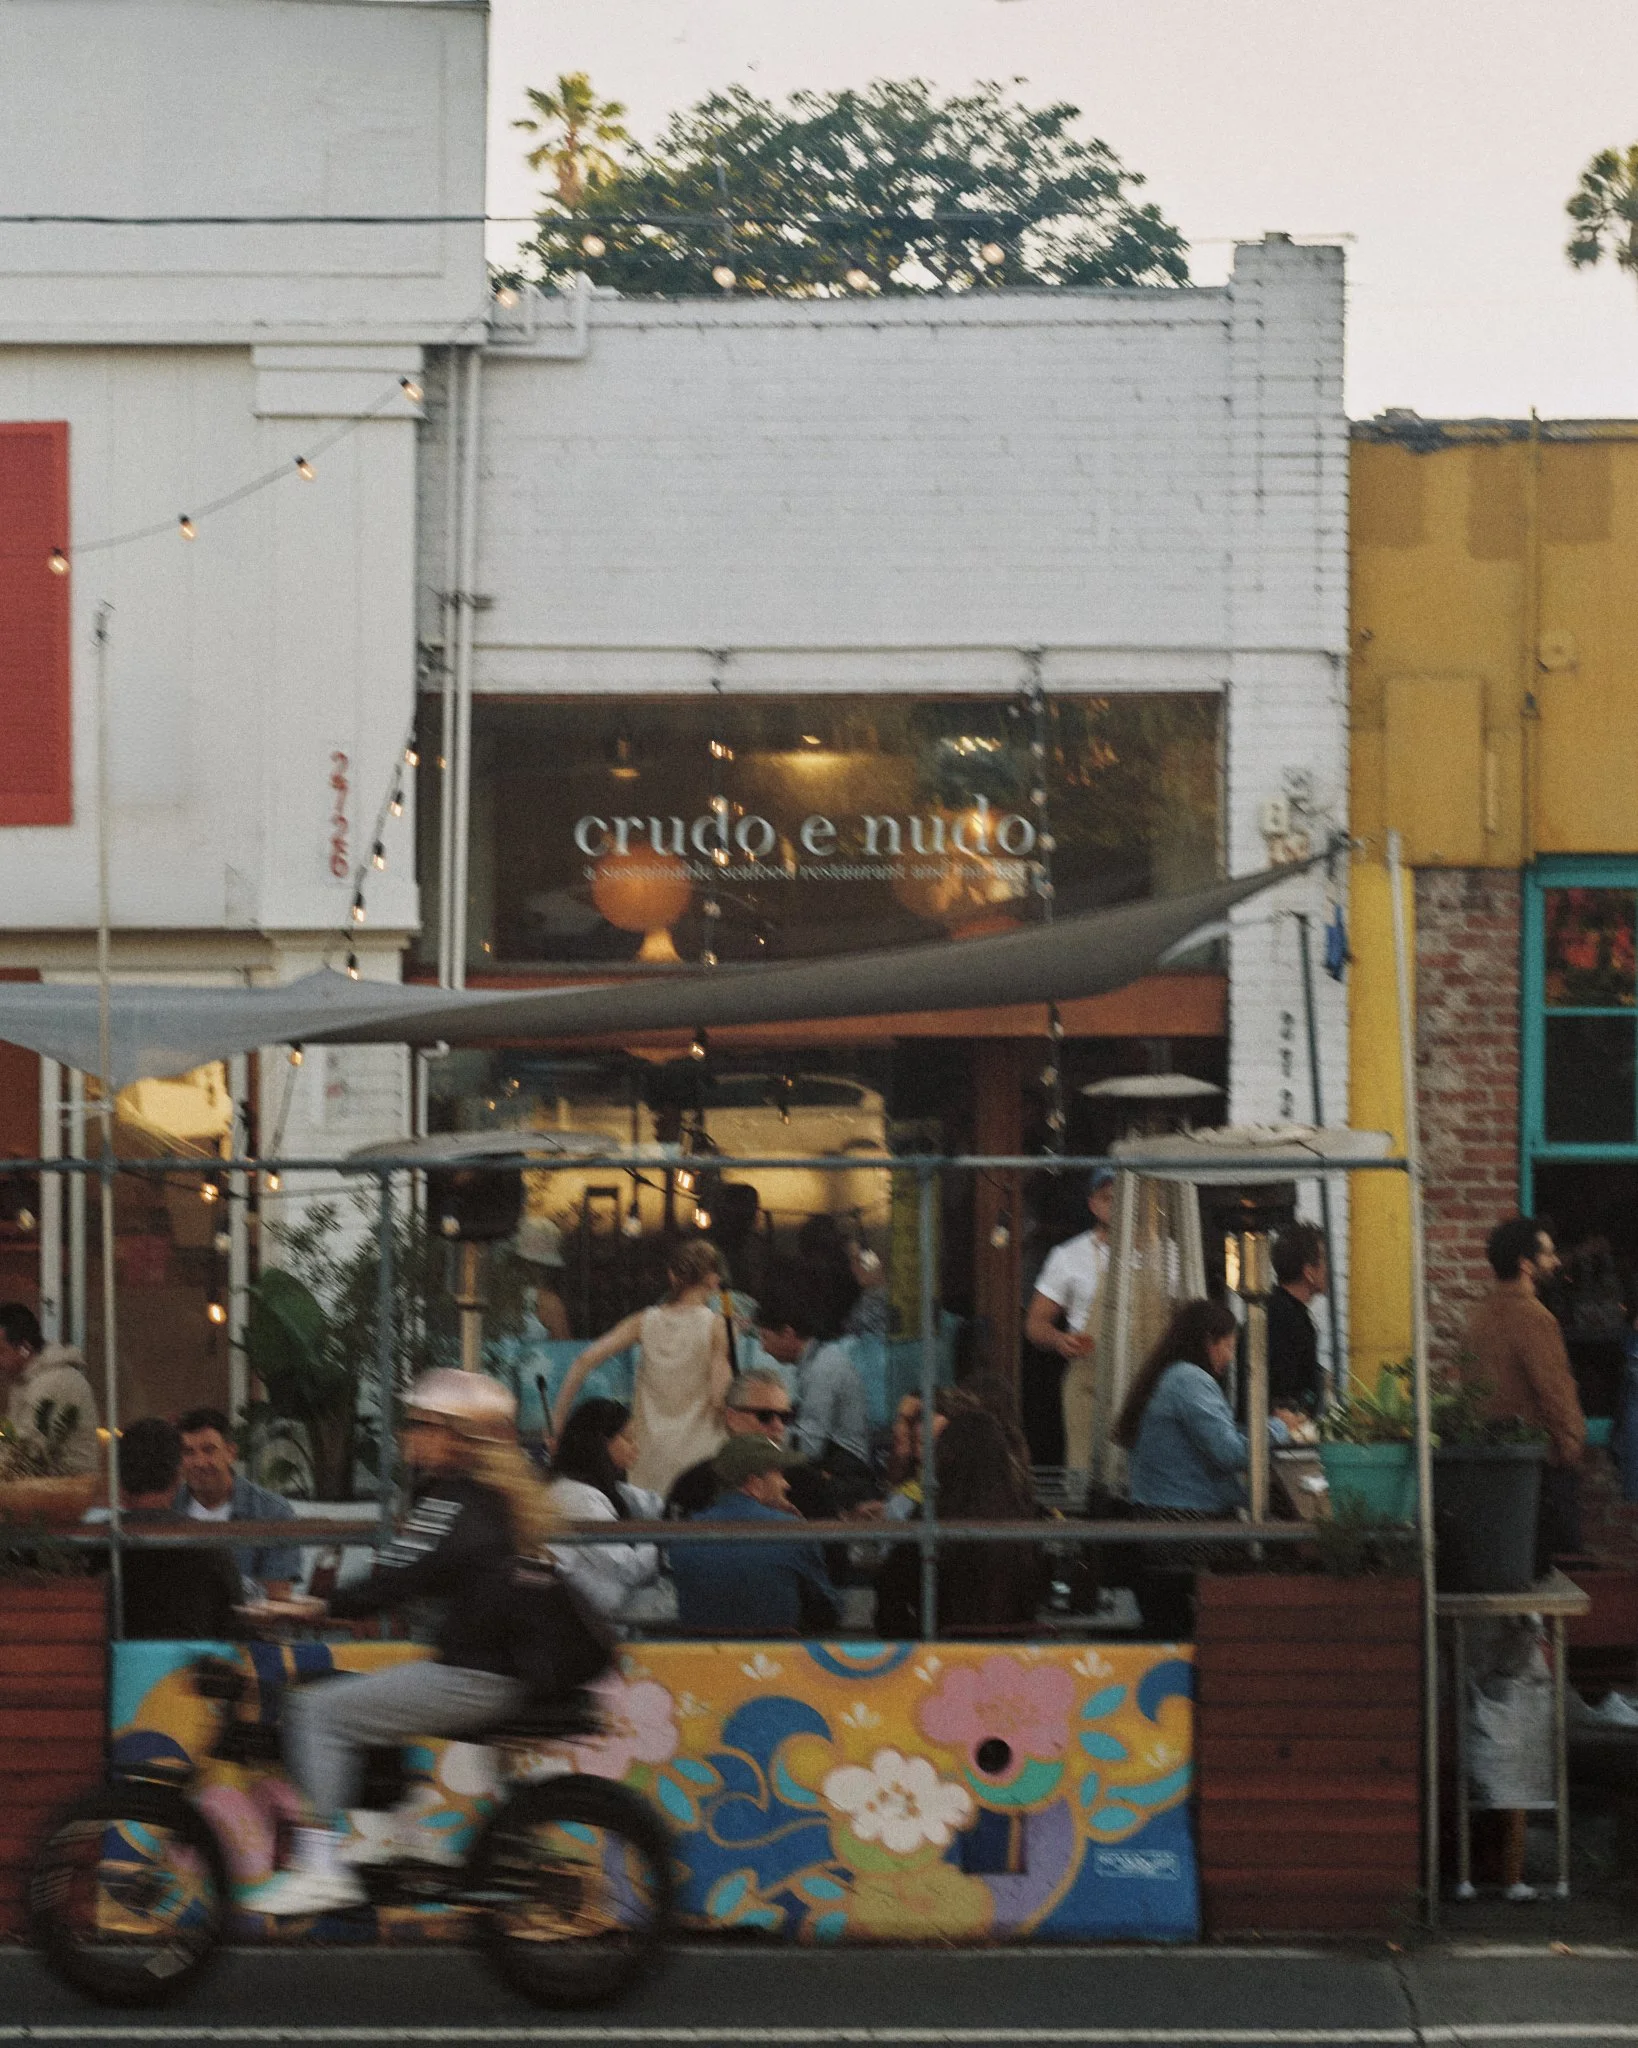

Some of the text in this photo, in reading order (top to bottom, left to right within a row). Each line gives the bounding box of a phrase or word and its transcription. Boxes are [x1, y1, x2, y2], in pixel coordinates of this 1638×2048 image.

[574, 793, 1037, 858] crudo e nudo
